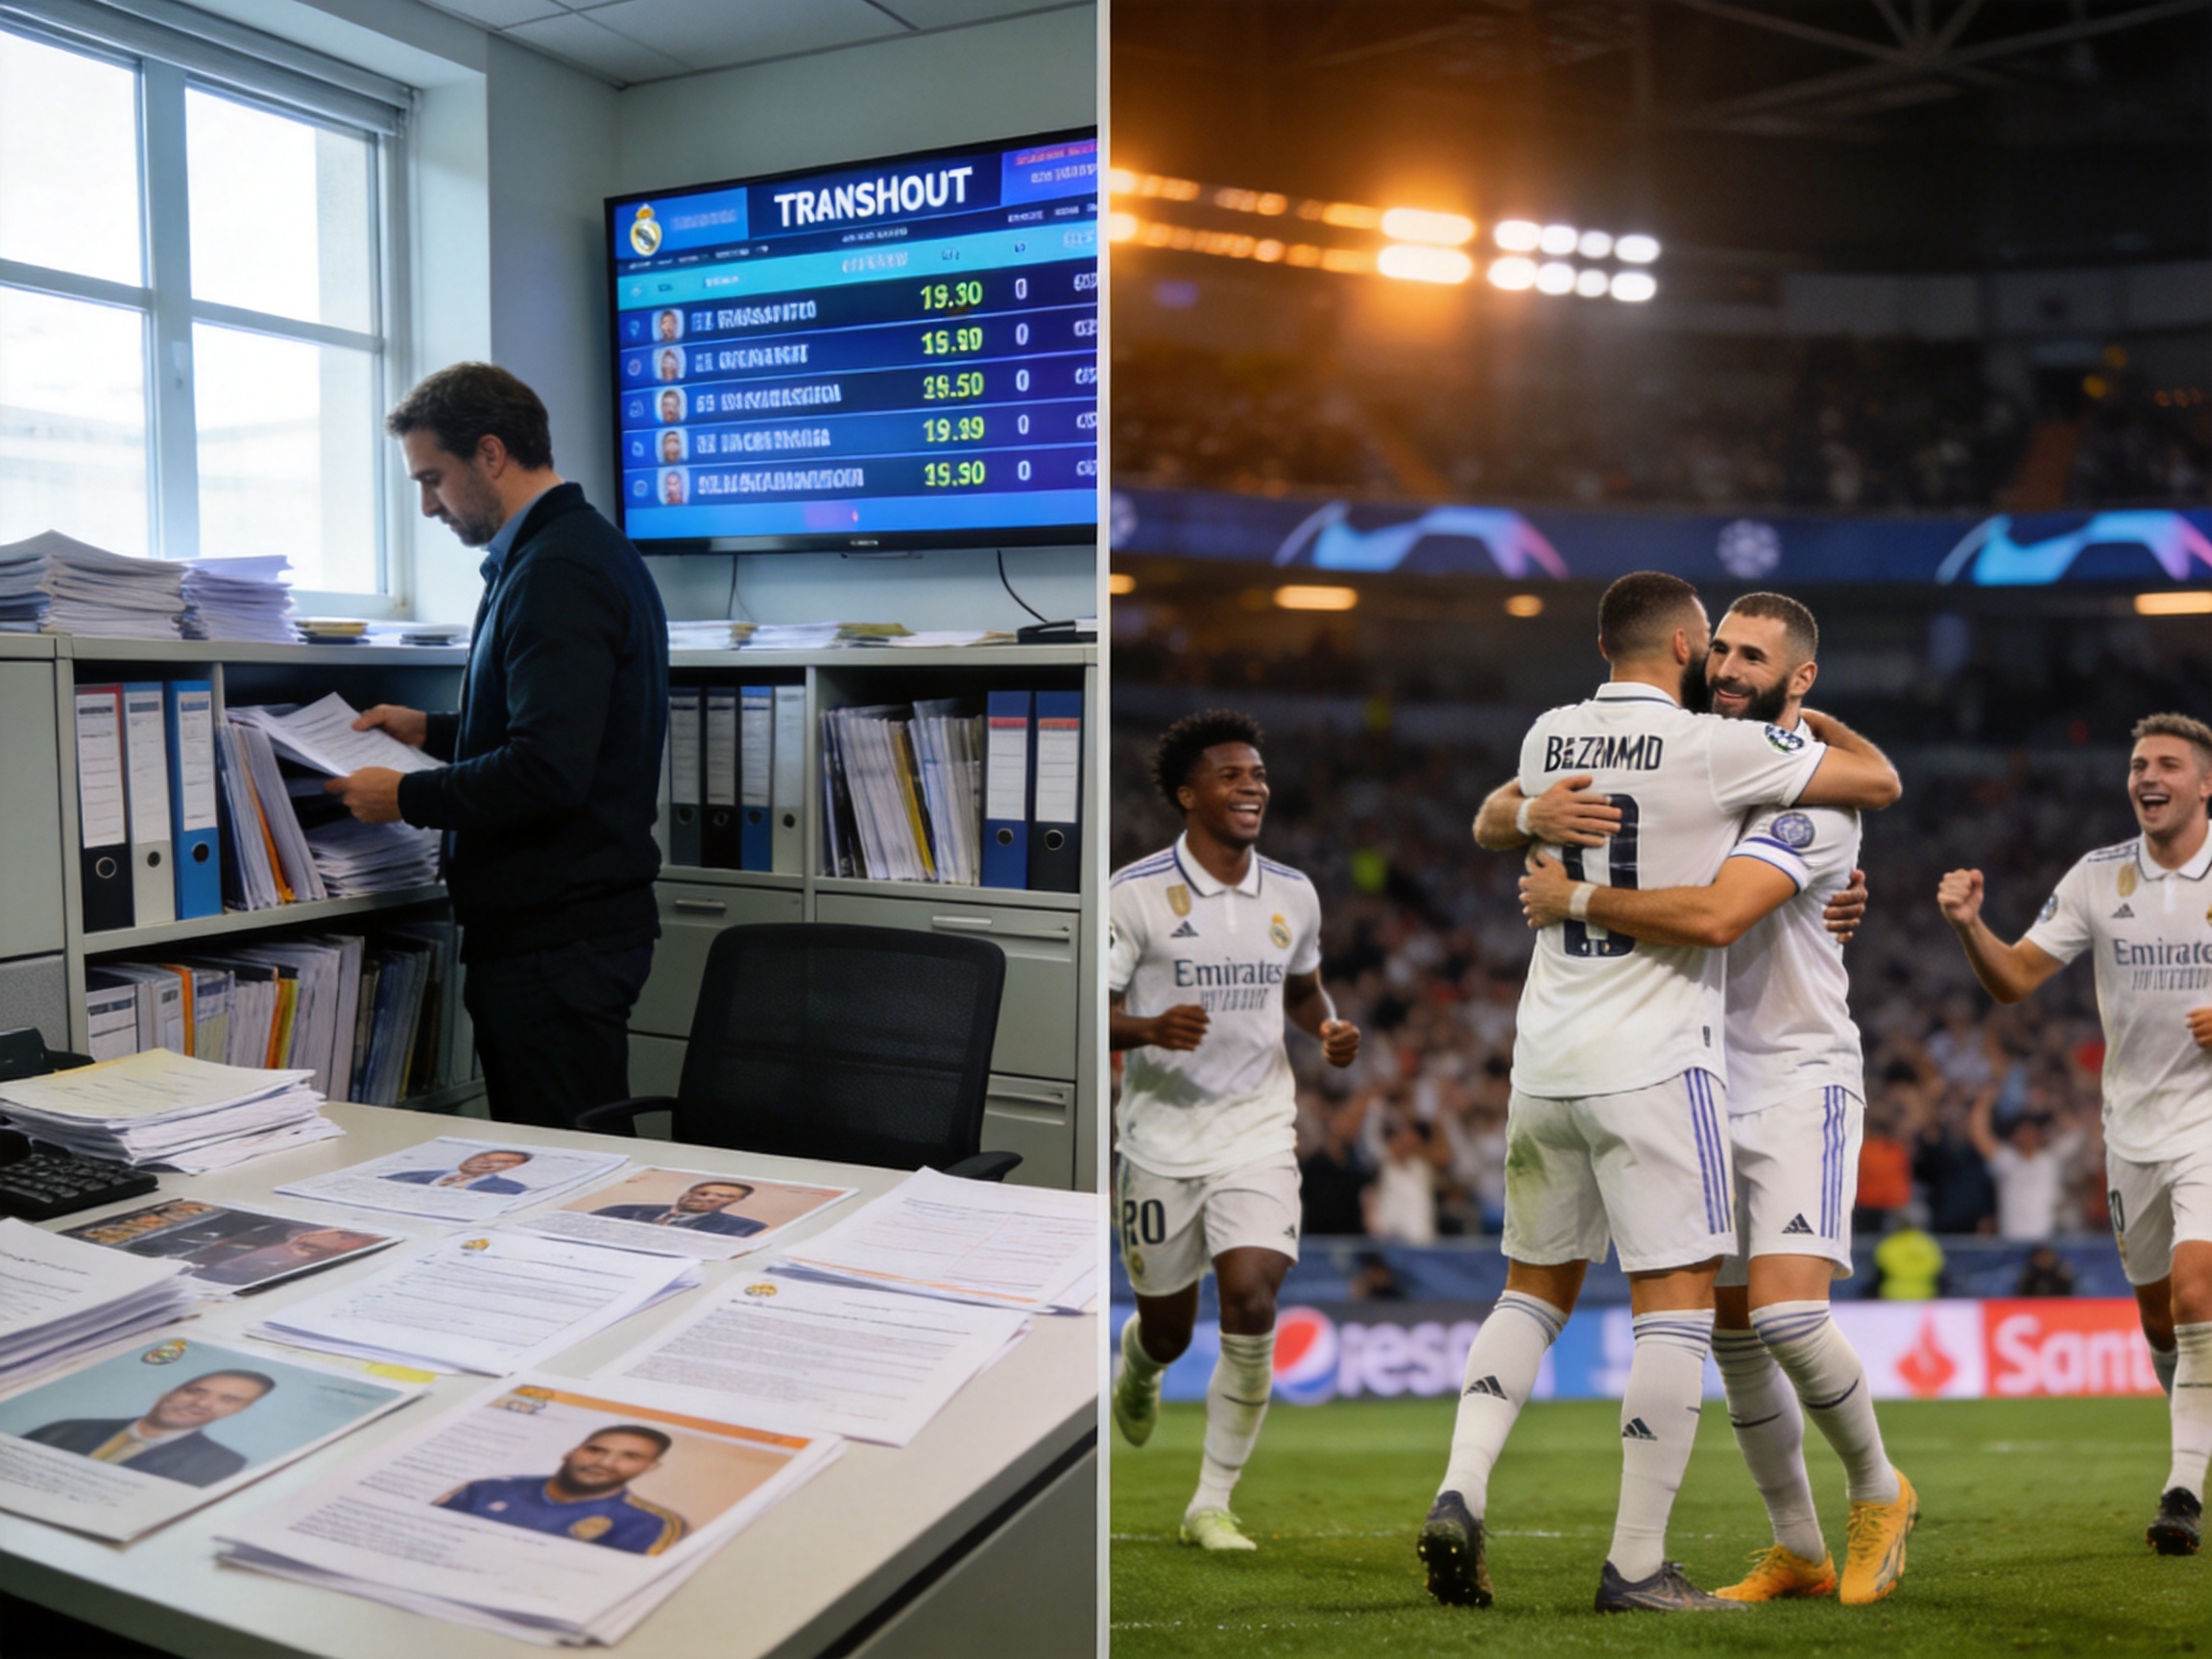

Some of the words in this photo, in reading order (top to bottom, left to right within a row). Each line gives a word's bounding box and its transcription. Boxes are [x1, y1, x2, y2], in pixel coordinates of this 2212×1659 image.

[773, 165, 974, 228] TRANSHOUT
[1015, 277, 1028, 301] 0
[1015, 323, 1029, 346] 0
[1015, 369, 1030, 392] 0
[1017, 414, 1030, 435] 0
[1017, 459, 1031, 481] 0
[1172, 956, 1284, 988] Emirates
